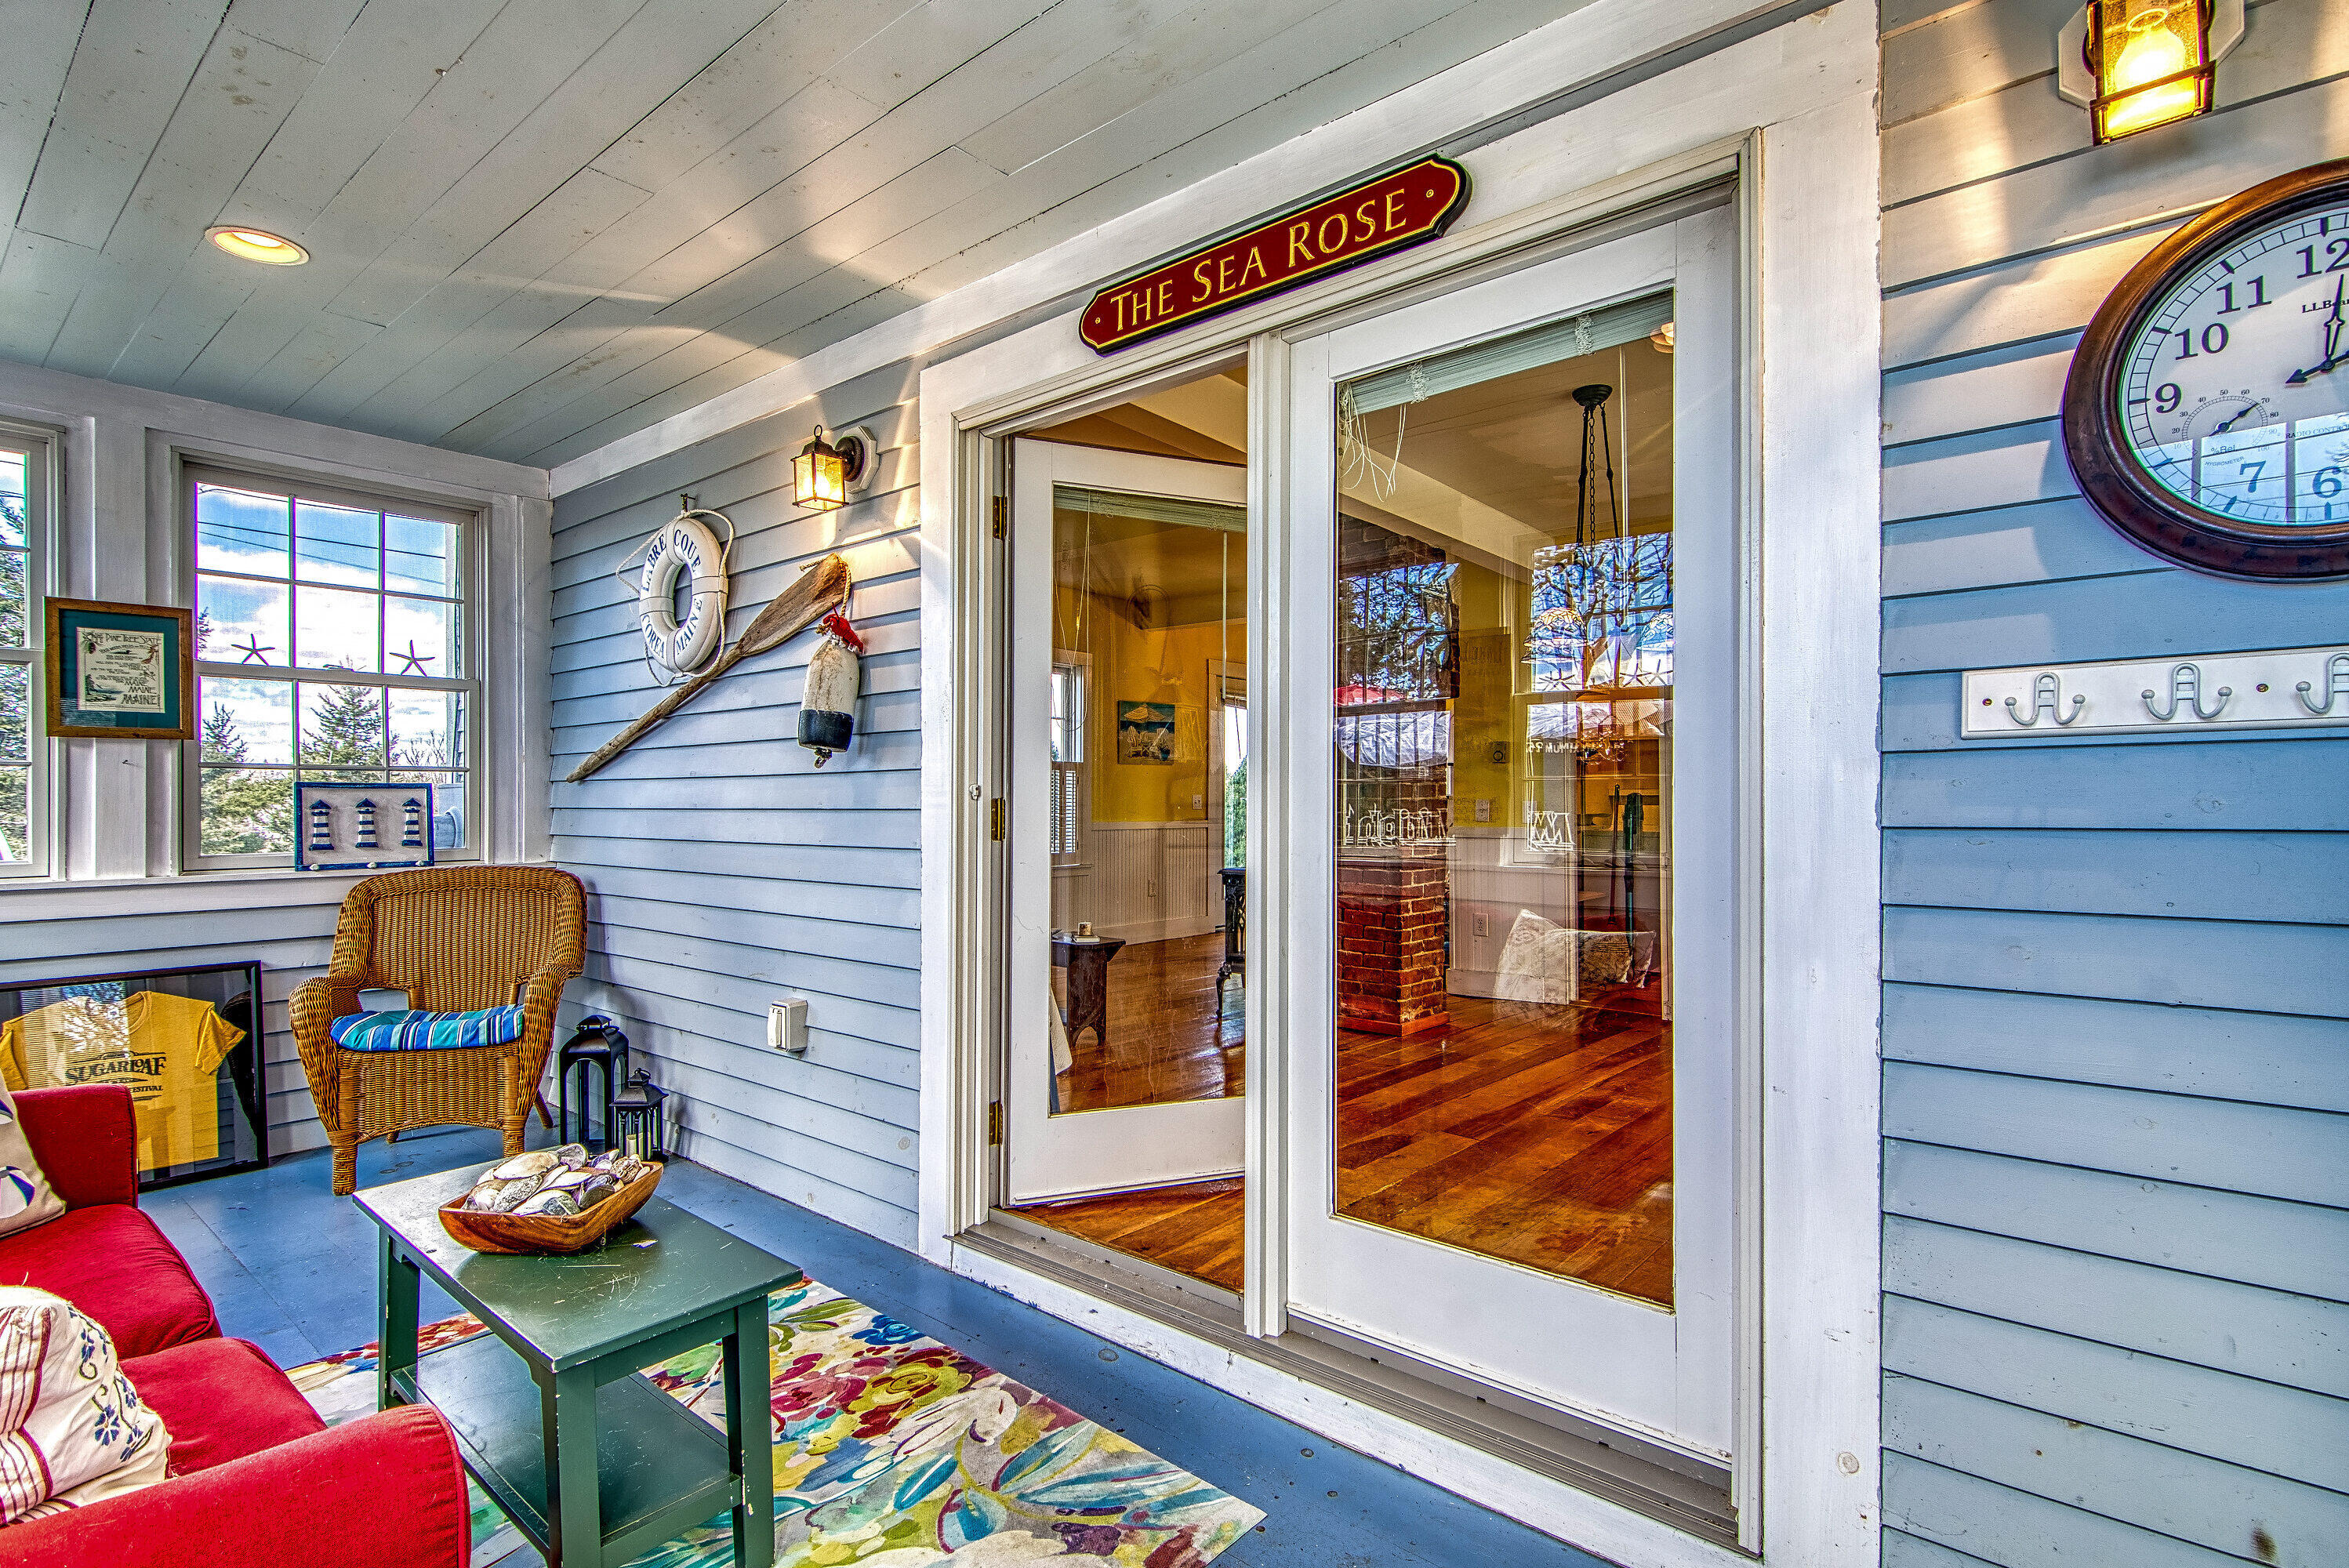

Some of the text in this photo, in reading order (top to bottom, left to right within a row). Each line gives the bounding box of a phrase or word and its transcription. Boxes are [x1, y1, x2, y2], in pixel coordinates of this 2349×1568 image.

[1110, 188, 1407, 332] THE SEA ROSE
[2296, 238, 2349, 279] 12
[2216, 274, 2272, 315] 11
[2174, 322, 2230, 361] 10
[2155, 383, 2182, 414] 9
[2285, 430, 2311, 439] RADIO
[2239, 460, 2267, 493] 7
[2312, 466, 2342, 499] 6
[673, 528, 702, 573] COQUE
[641, 597, 703, 659] COREA MAINE
